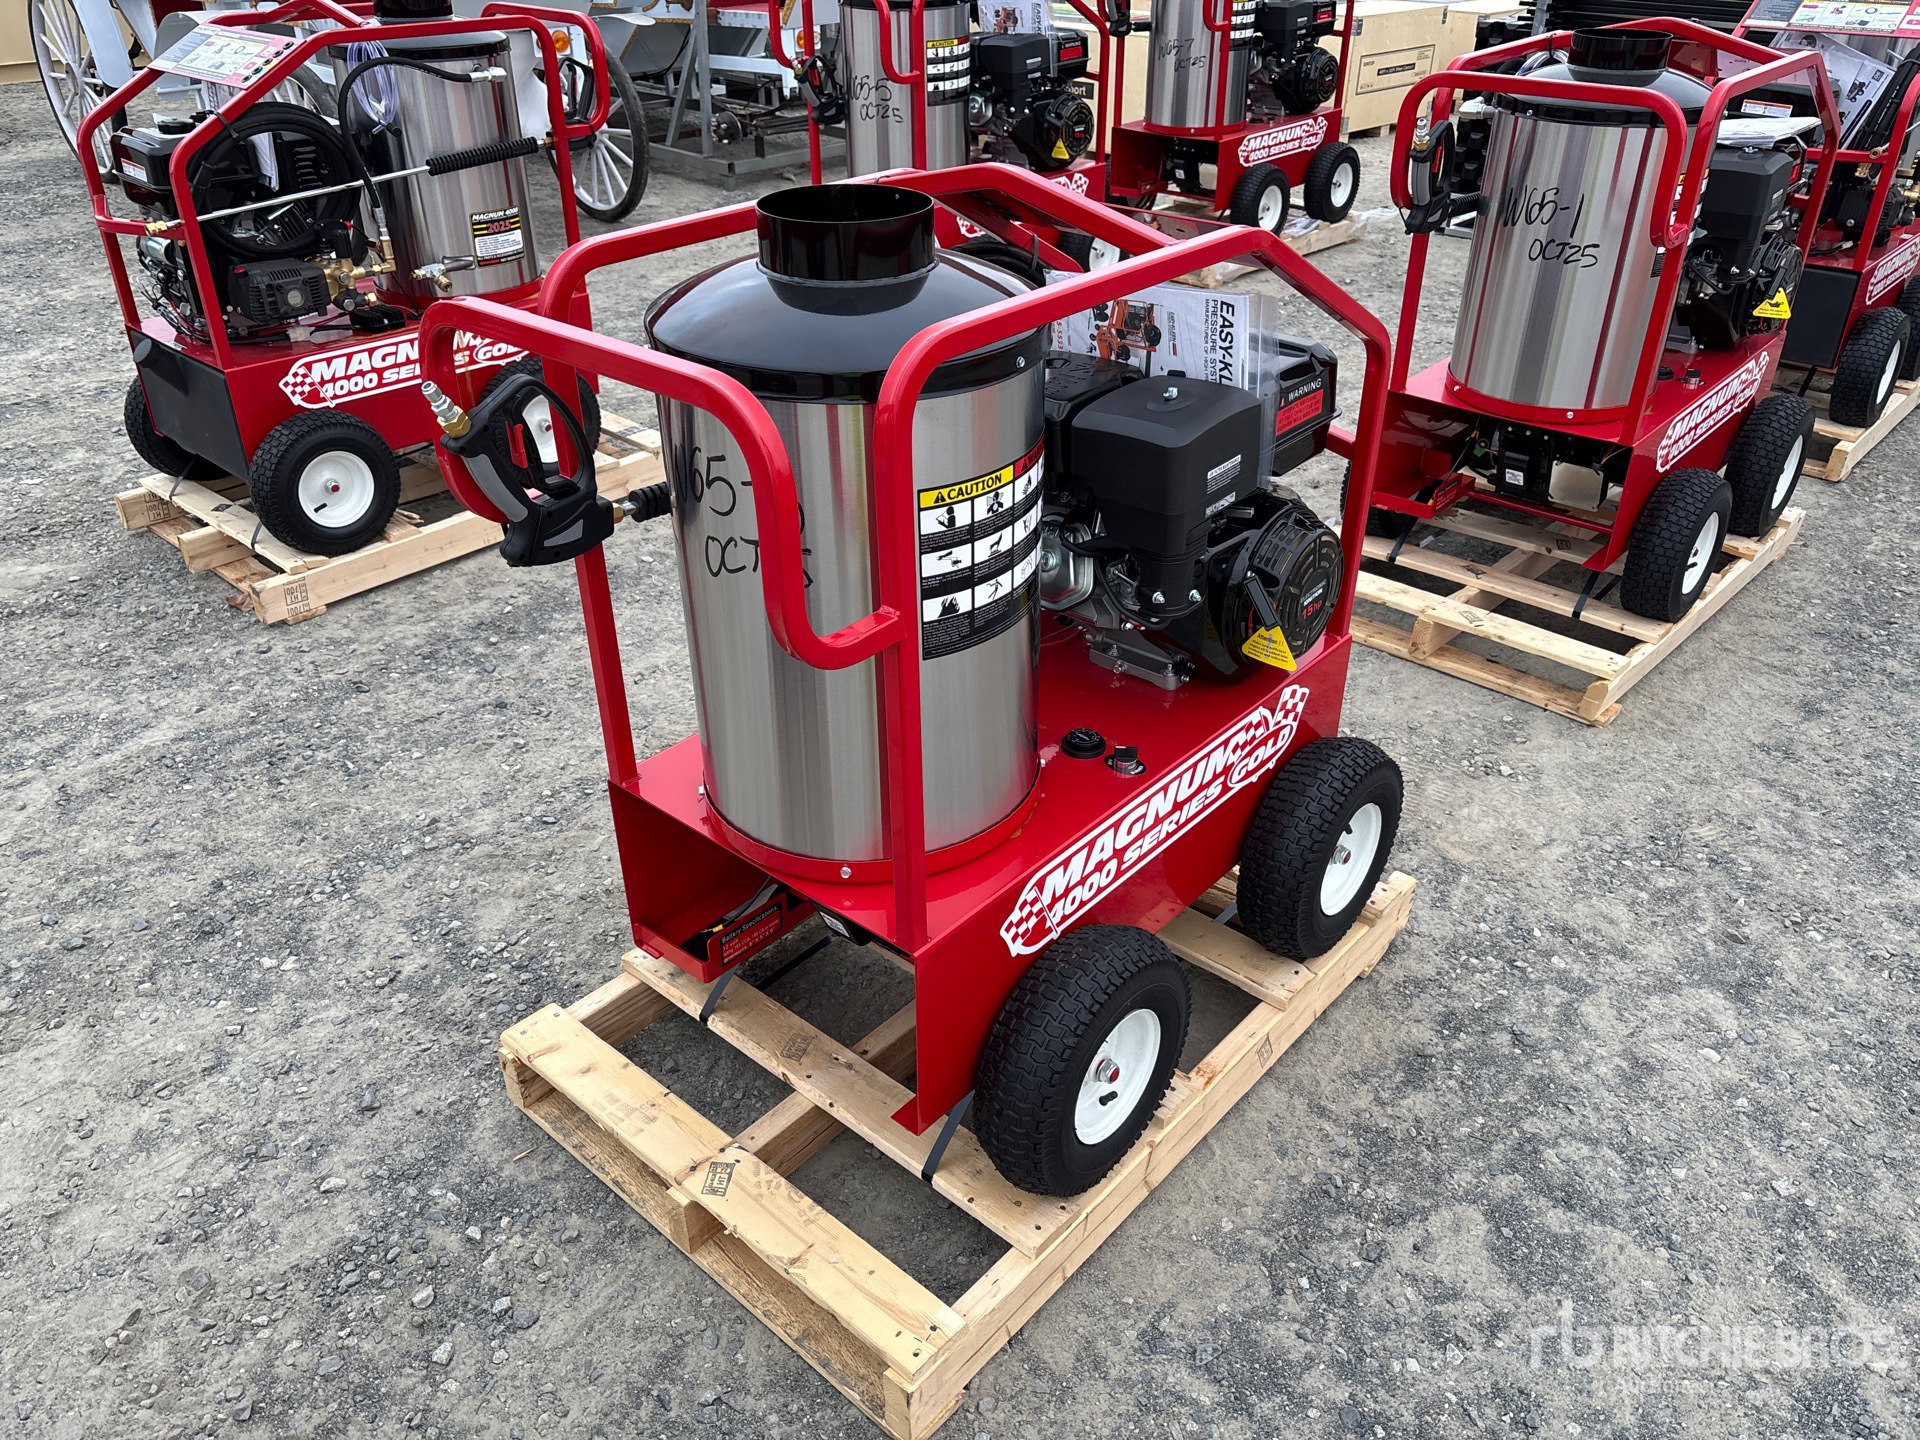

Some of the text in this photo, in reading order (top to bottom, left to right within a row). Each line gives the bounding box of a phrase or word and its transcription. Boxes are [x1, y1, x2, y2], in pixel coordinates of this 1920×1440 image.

[1174, 55, 1206, 73] OCT25
[860, 102, 904, 123] OCT25
[1248, 125, 1305, 150] MAGNUM
[1269, 140, 1300, 155] SERIES
[1302, 133, 1322, 146] GOLD
[472, 211, 504, 221] MAGNUM
[1503, 184, 1584, 239] W65-1
[486, 220, 511, 233] 2025
[1528, 239, 1600, 268] OCT25
[1210, 299, 1219, 354] PRESSURE
[1219, 300, 1235, 384] EASY-KL
[320, 373, 378, 398] 4000
[1288, 378, 1322, 401] WARNING
[1671, 376, 1744, 440] MAGNUM
[1694, 400, 1733, 439] SERIES
[947, 472, 1002, 501] CAUTION
[290, 594, 299, 603] HT
[1040, 732, 1252, 907] MAGNUM
[1046, 730, 1289, 928] 4000 SERIES GOLD
[722, 929, 741, 943] Battery
[716, 1175, 727, 1186] HT
